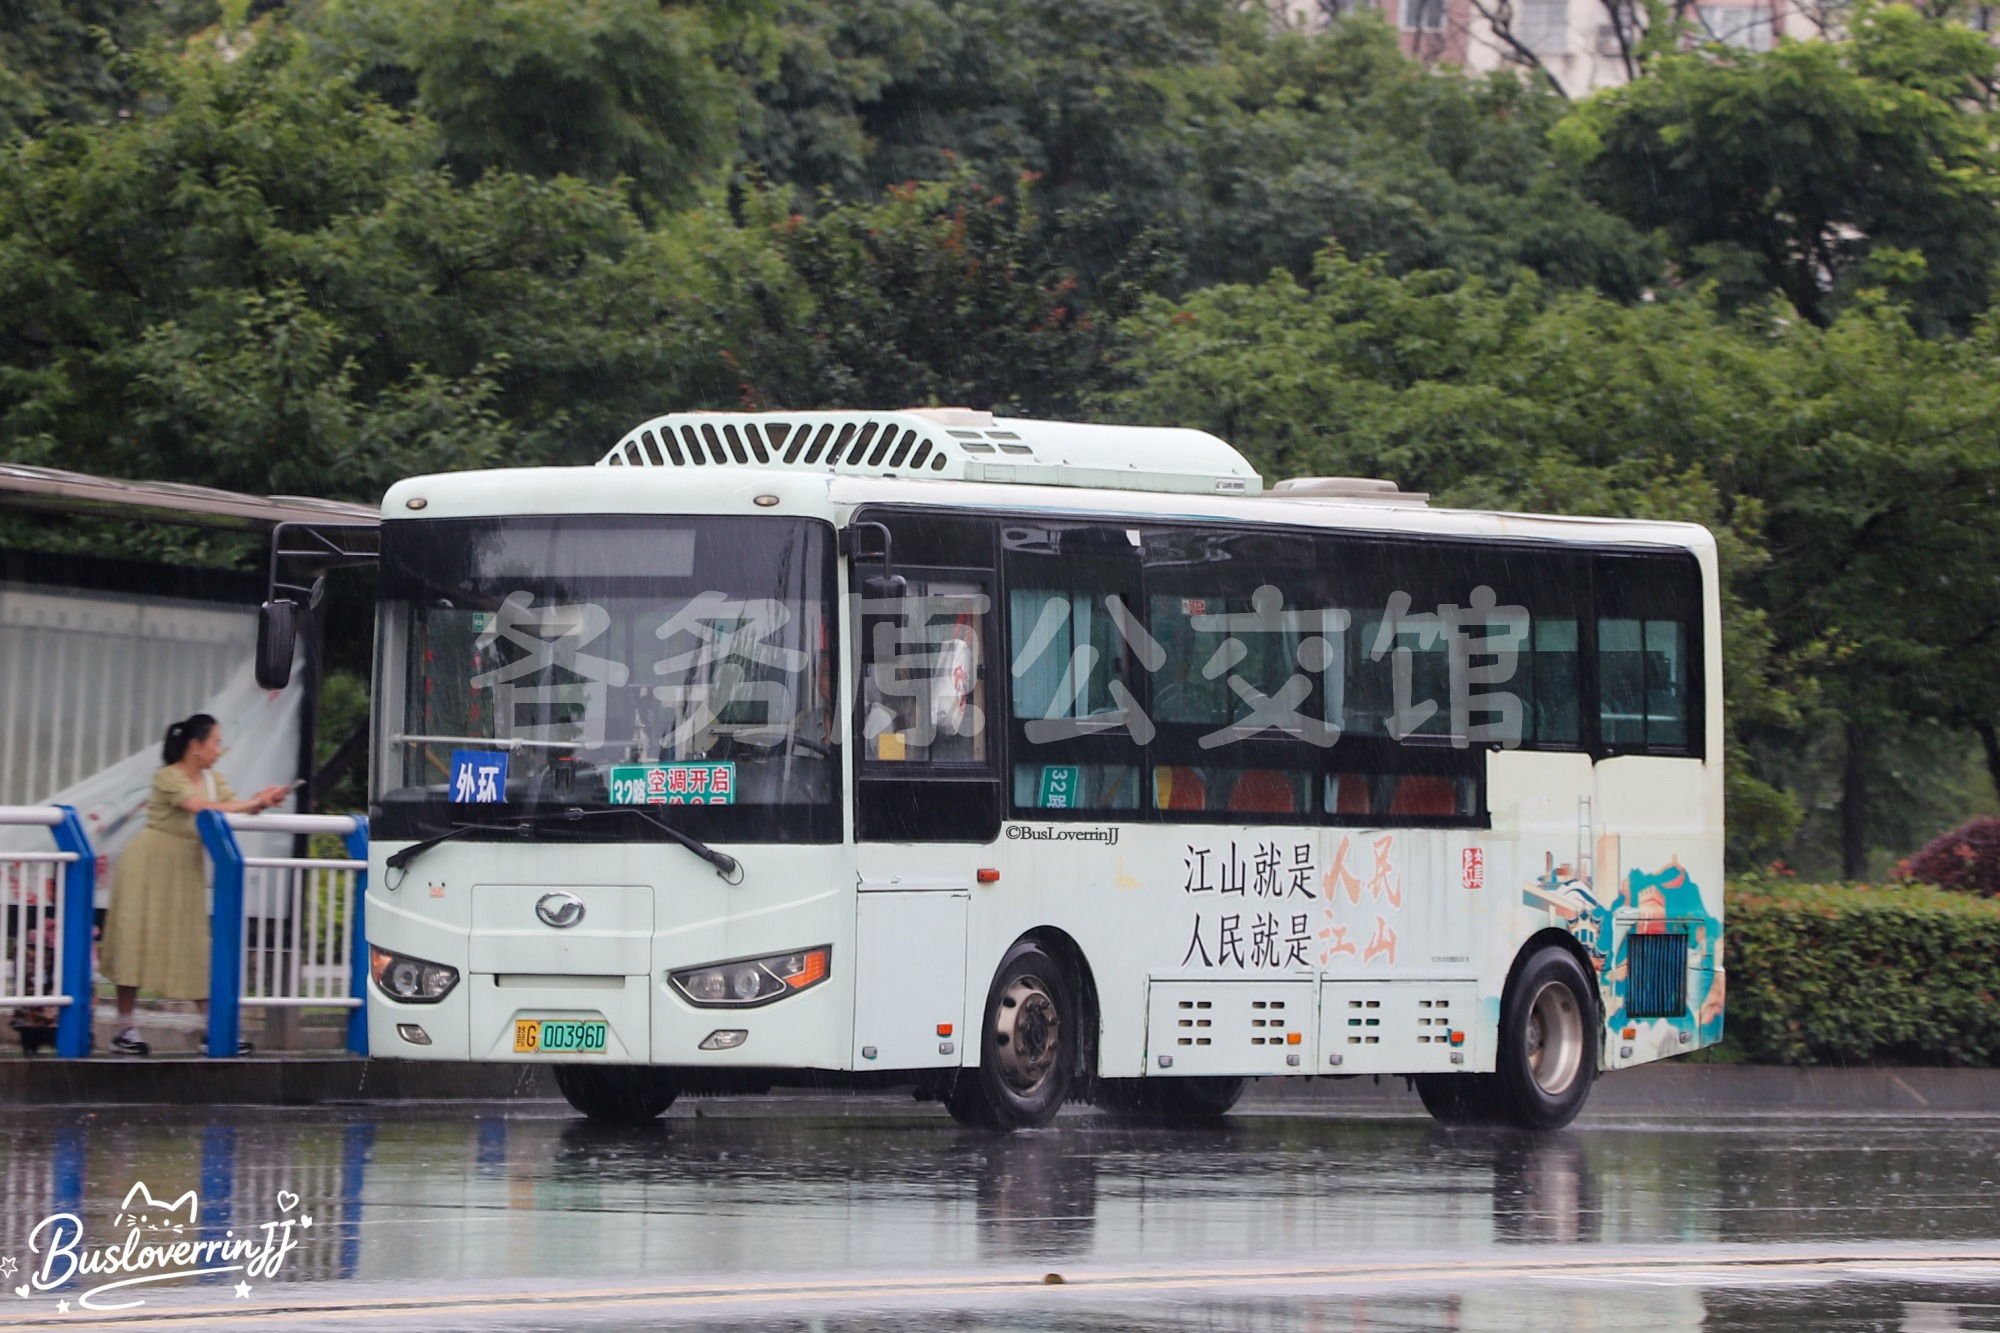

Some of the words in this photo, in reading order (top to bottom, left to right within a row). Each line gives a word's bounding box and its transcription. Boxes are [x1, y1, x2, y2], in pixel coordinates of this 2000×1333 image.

[455, 763, 500, 803] 外环
[647, 767, 730, 794] 空调开启
[1183, 834, 1402, 908] 江山就是人民
[1181, 909, 1397, 969] 人民就是江山
